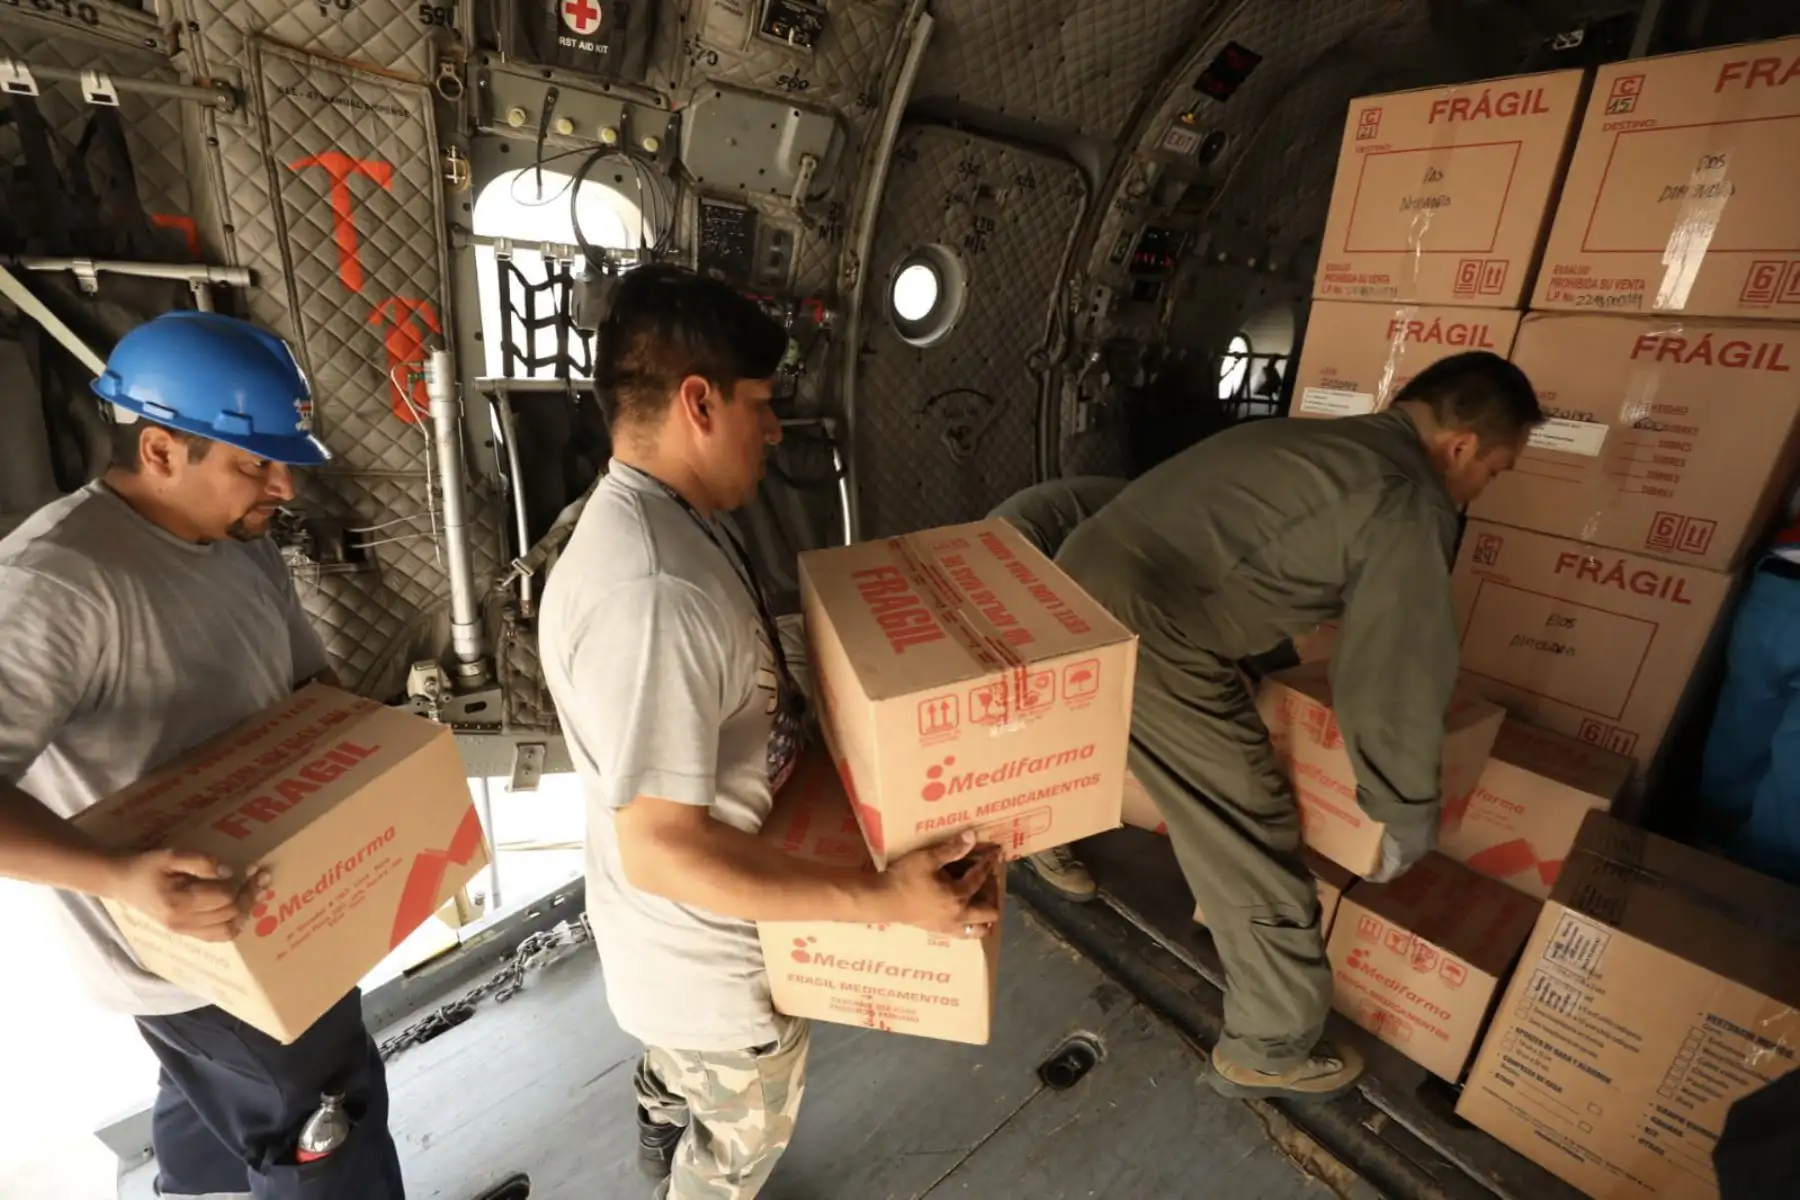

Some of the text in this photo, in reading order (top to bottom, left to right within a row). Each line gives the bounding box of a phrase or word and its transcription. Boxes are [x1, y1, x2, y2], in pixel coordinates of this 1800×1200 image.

[559, 36, 609, 54] RST AID KIT
[1621, 80, 1634, 94] C
[1366, 110, 1377, 125] C
[1428, 88, 1550, 124] FRÁGIL
[1461, 264, 1476, 284] 6
[1550, 277, 1646, 291] PROHIBIDA SU VENTA
[1753, 265, 1777, 290] 6
[1387, 317, 1495, 348] FRÁGIL
[1630, 333, 1790, 372] FRÁGIL
[1657, 516, 1676, 537] 6
[1554, 552, 1692, 605] FRÁGIL
[852, 565, 946, 655] FRAGIL
[947, 743, 1096, 796] Medifarma
[210, 740, 382, 841] FRAGIL
[915, 809, 971, 834] FRAGIL
[976, 772, 1101, 818] MEDICAMENTOS
[1476, 788, 1526, 815] farma
[279, 825, 396, 923] Medifarma
[810, 951, 952, 984] Medifarma
[787, 973, 837, 990] FRAGIL
[840, 979, 960, 1008] MEDICAMENTOS
[1360, 963, 1452, 1021] Medifarma
[1369, 988, 1450, 1042] MEDICAMENTOS
